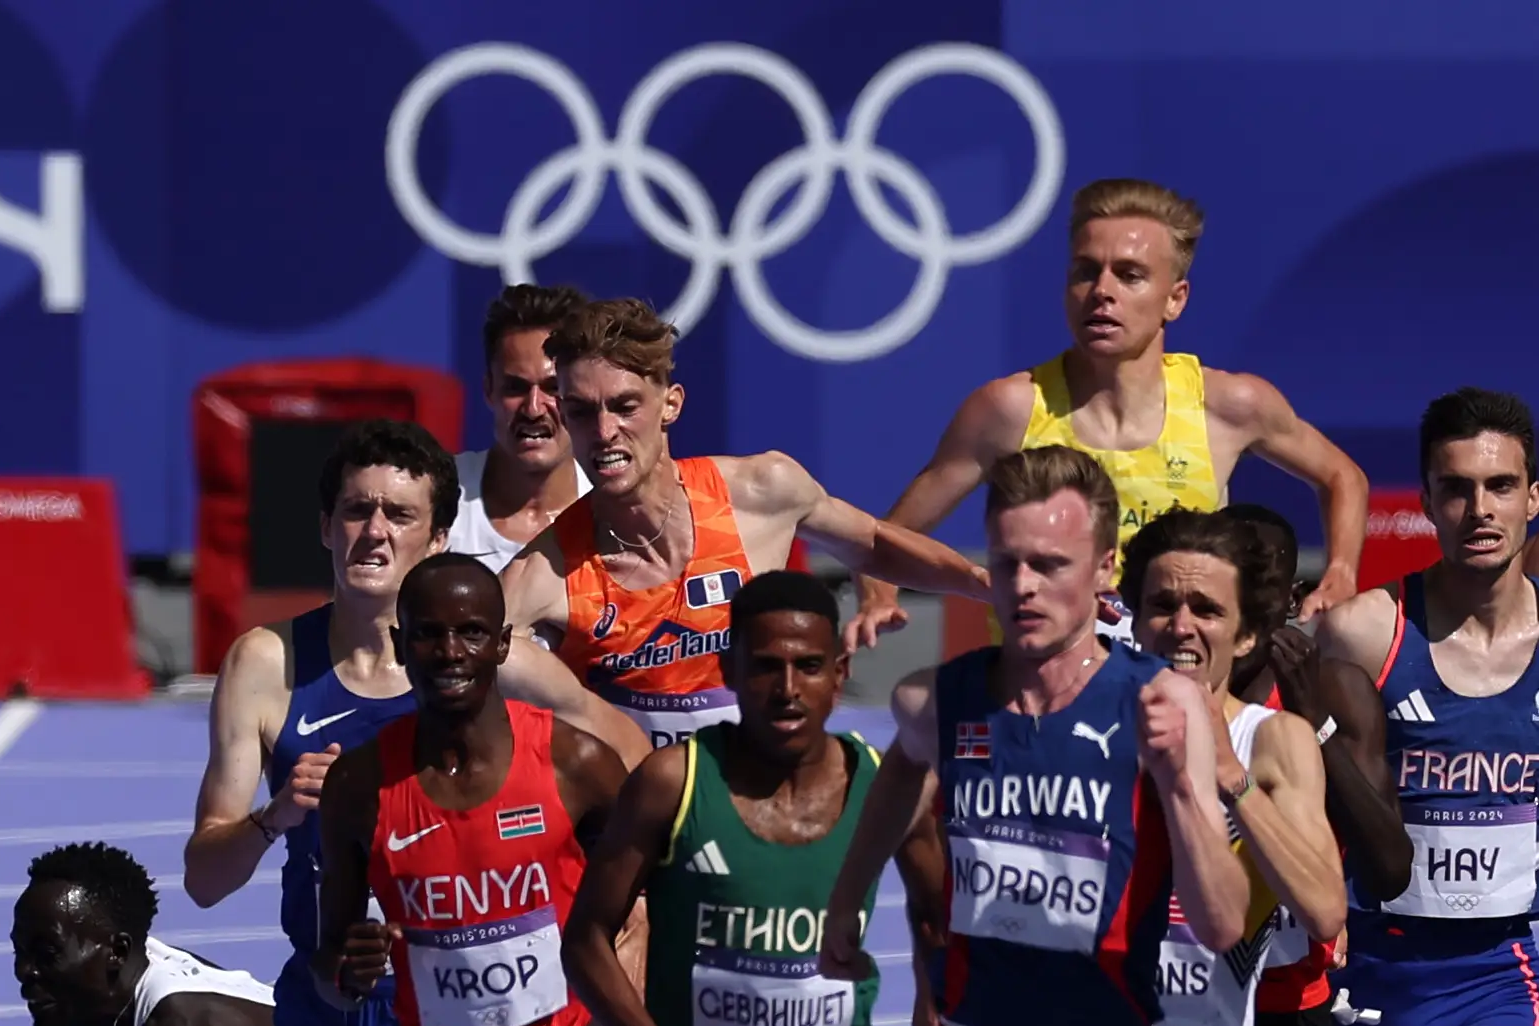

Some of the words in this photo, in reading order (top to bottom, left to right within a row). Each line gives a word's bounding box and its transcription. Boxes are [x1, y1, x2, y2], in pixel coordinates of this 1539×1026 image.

[631, 695, 668, 708] PARIS
[673, 695, 709, 708] 2024
[1398, 749, 1539, 794] FRANCE
[954, 774, 1111, 823] NORWAY
[1425, 809, 1464, 822] PARIS
[1468, 809, 1503, 822] 2024
[984, 823, 1024, 841] PARIS
[1428, 847, 1501, 882] HAY
[398, 862, 550, 922] KENYA
[953, 856, 1100, 917] NORDAS
[434, 931, 475, 945] PARIS
[478, 923, 516, 940] 2024
[695, 902, 866, 952] ETHIO
[434, 954, 539, 999] KROP
[735, 956, 777, 974] PARIS
